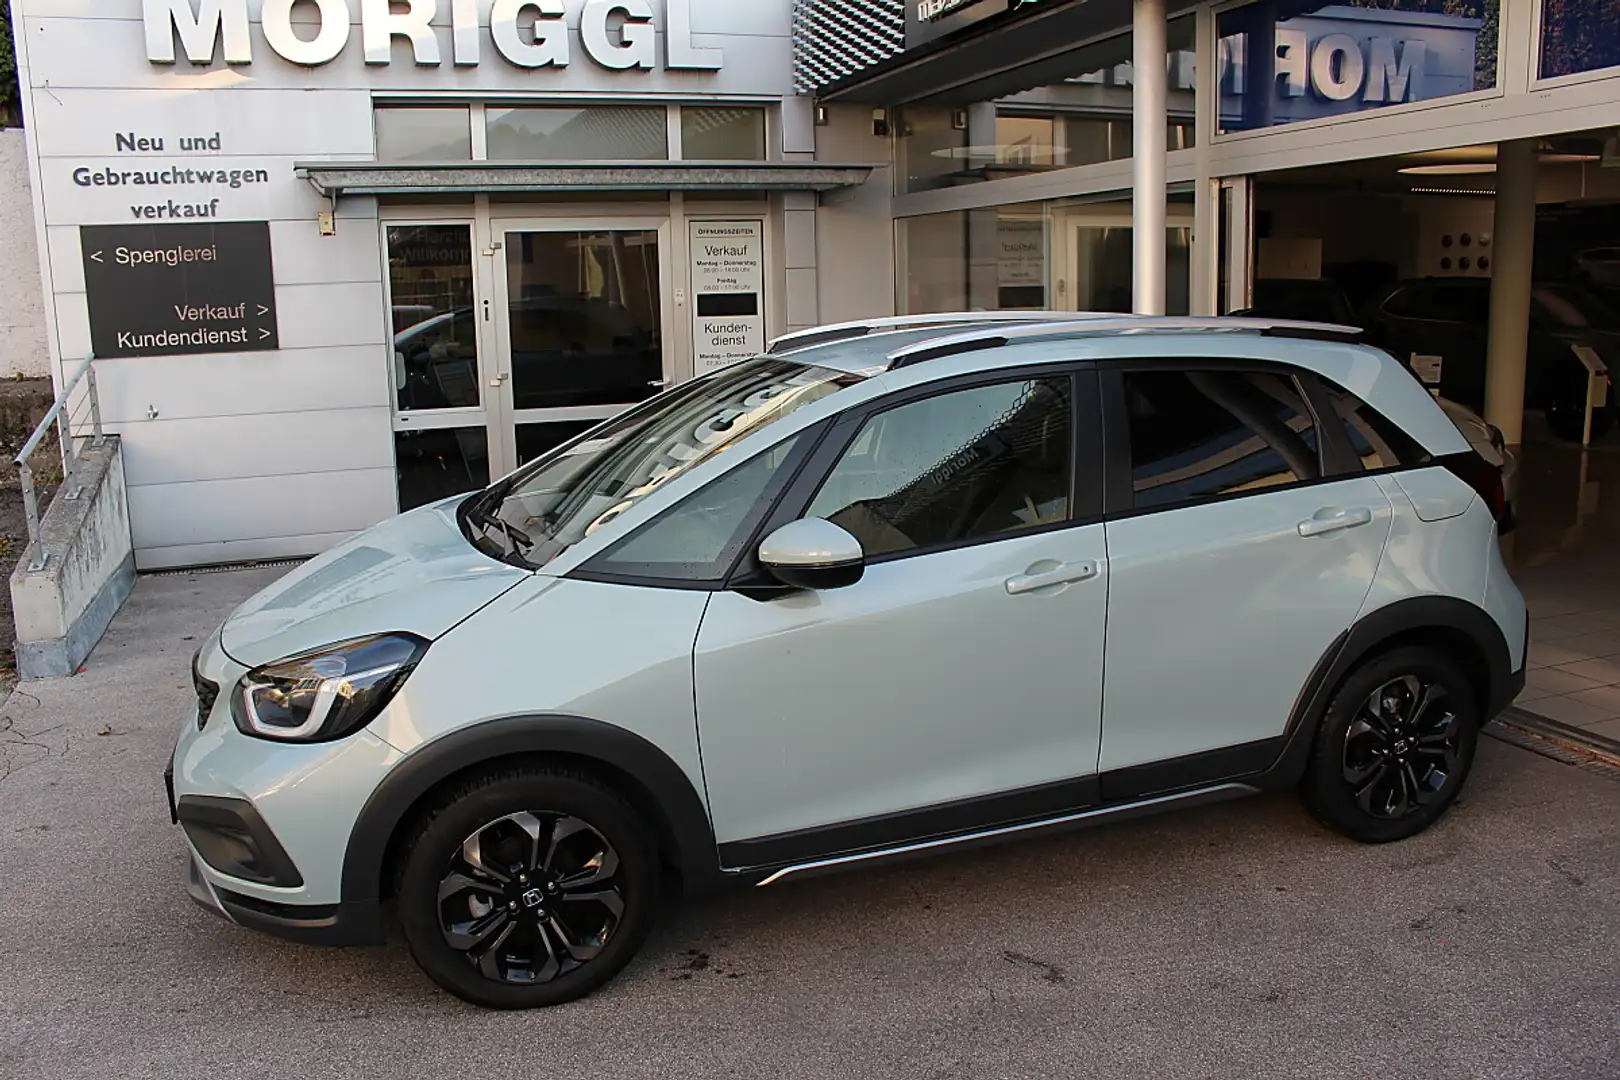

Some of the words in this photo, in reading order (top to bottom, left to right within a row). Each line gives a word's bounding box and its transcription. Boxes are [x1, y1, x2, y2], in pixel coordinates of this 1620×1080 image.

[142, 0, 724, 72] MORIGGL
[115, 132, 164, 151] Neu
[179, 132, 221, 150] und
[72, 166, 268, 188] Gebrauchtwagen
[130, 199, 220, 218] verkauf
[115, 245, 217, 267] Spenglerei
[704, 245, 748, 256] Verkauf
[174, 303, 246, 321] Verkauf
[117, 327, 248, 349] Kundendienst
[704, 323, 753, 334] Kunden-
[711, 335, 746, 346] dienst
